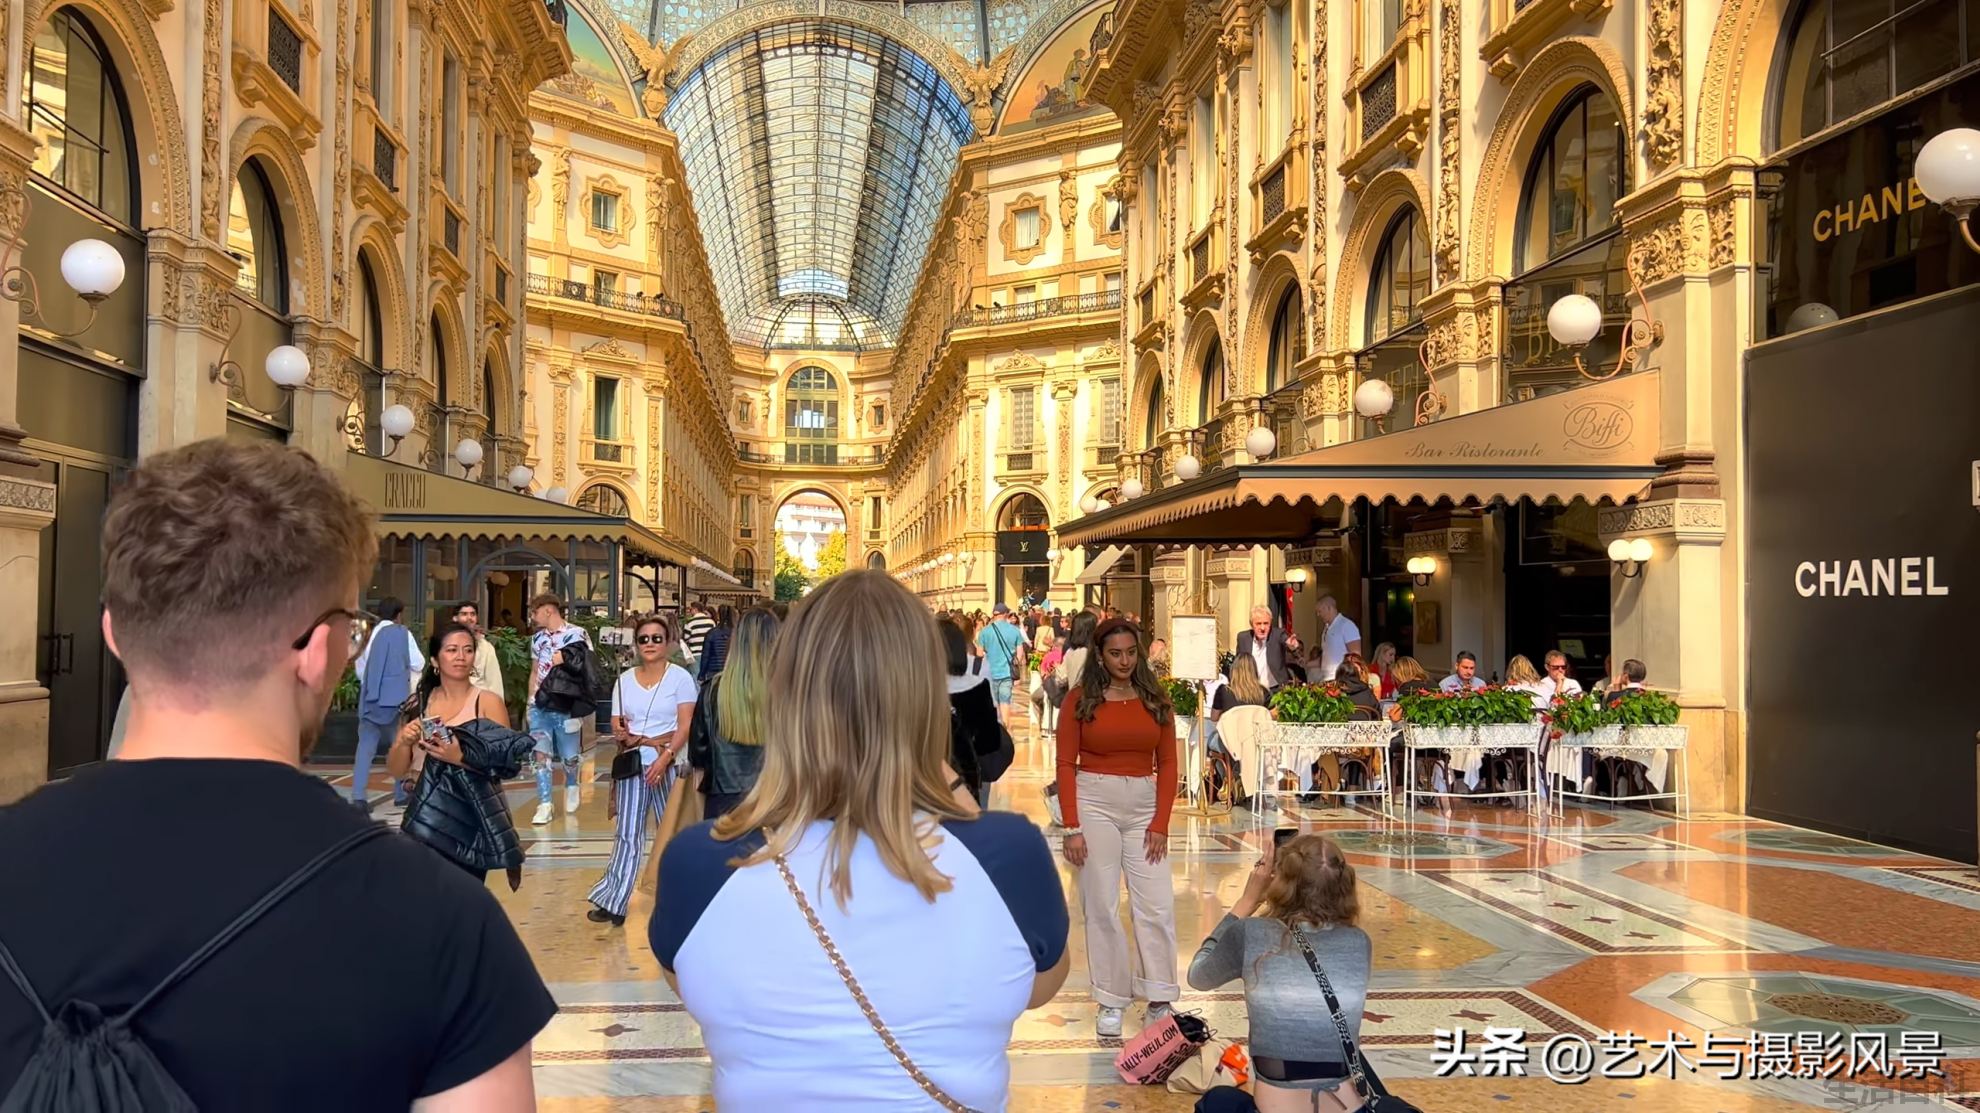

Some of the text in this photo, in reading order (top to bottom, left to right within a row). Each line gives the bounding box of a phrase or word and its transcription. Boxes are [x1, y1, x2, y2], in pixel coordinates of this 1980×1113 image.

[1812, 176, 1926, 242] CHANE
[1570, 405, 1626, 447] Biffi
[1405, 441, 1545, 458] Bar Ristorante
[1795, 556, 1949, 597] CHANEL
